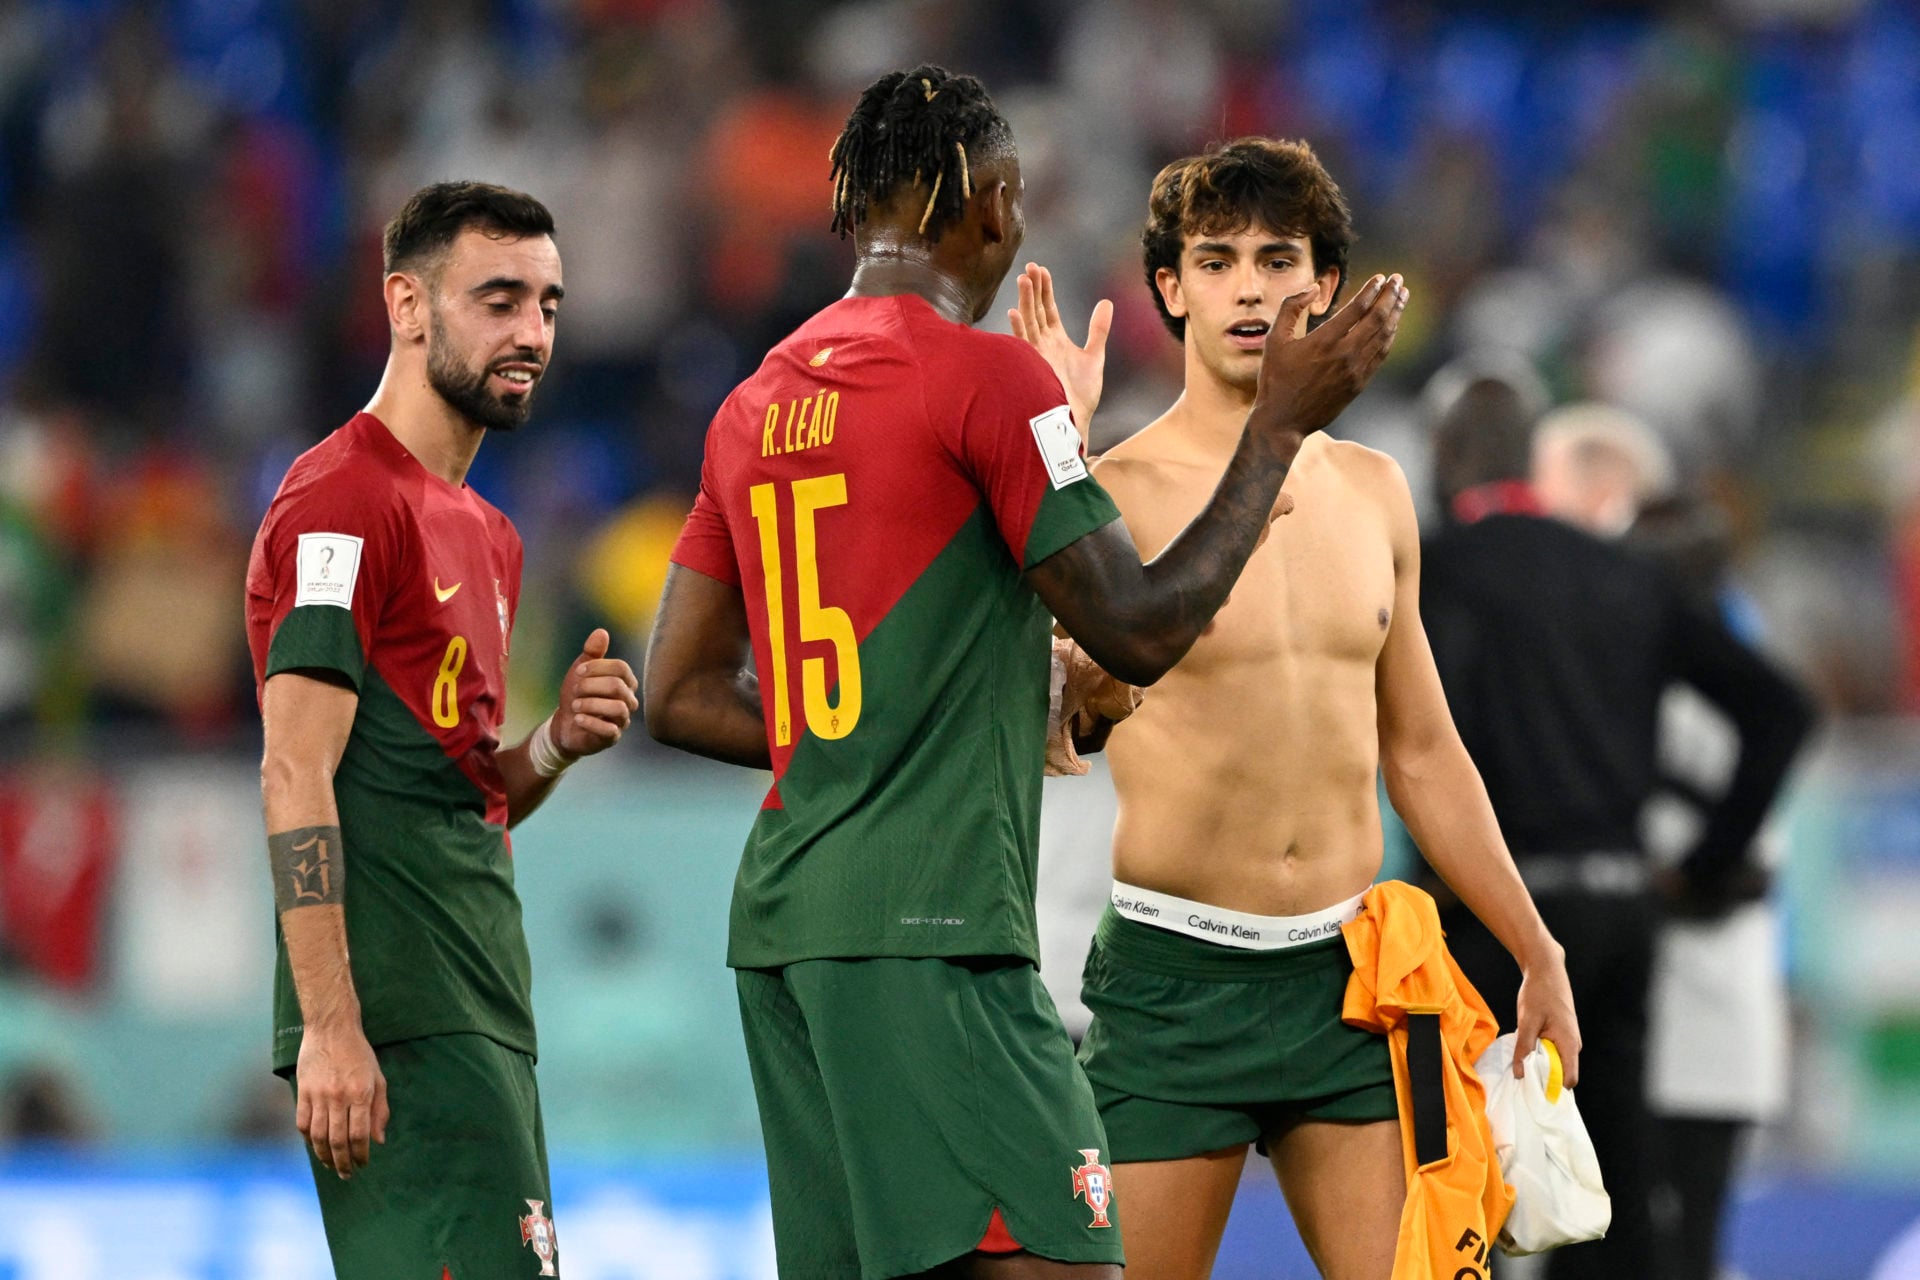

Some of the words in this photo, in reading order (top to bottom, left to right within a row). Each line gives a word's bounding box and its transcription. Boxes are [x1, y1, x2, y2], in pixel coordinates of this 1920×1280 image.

[749, 472, 862, 747] 15
[431, 635, 467, 729] 8
[1132, 900, 1160, 918] Klein
[1187, 914, 1228, 935] Calvin
[1231, 924, 1260, 941] Klein
[1287, 924, 1322, 942] Calvin
[1323, 917, 1343, 935] Klein
